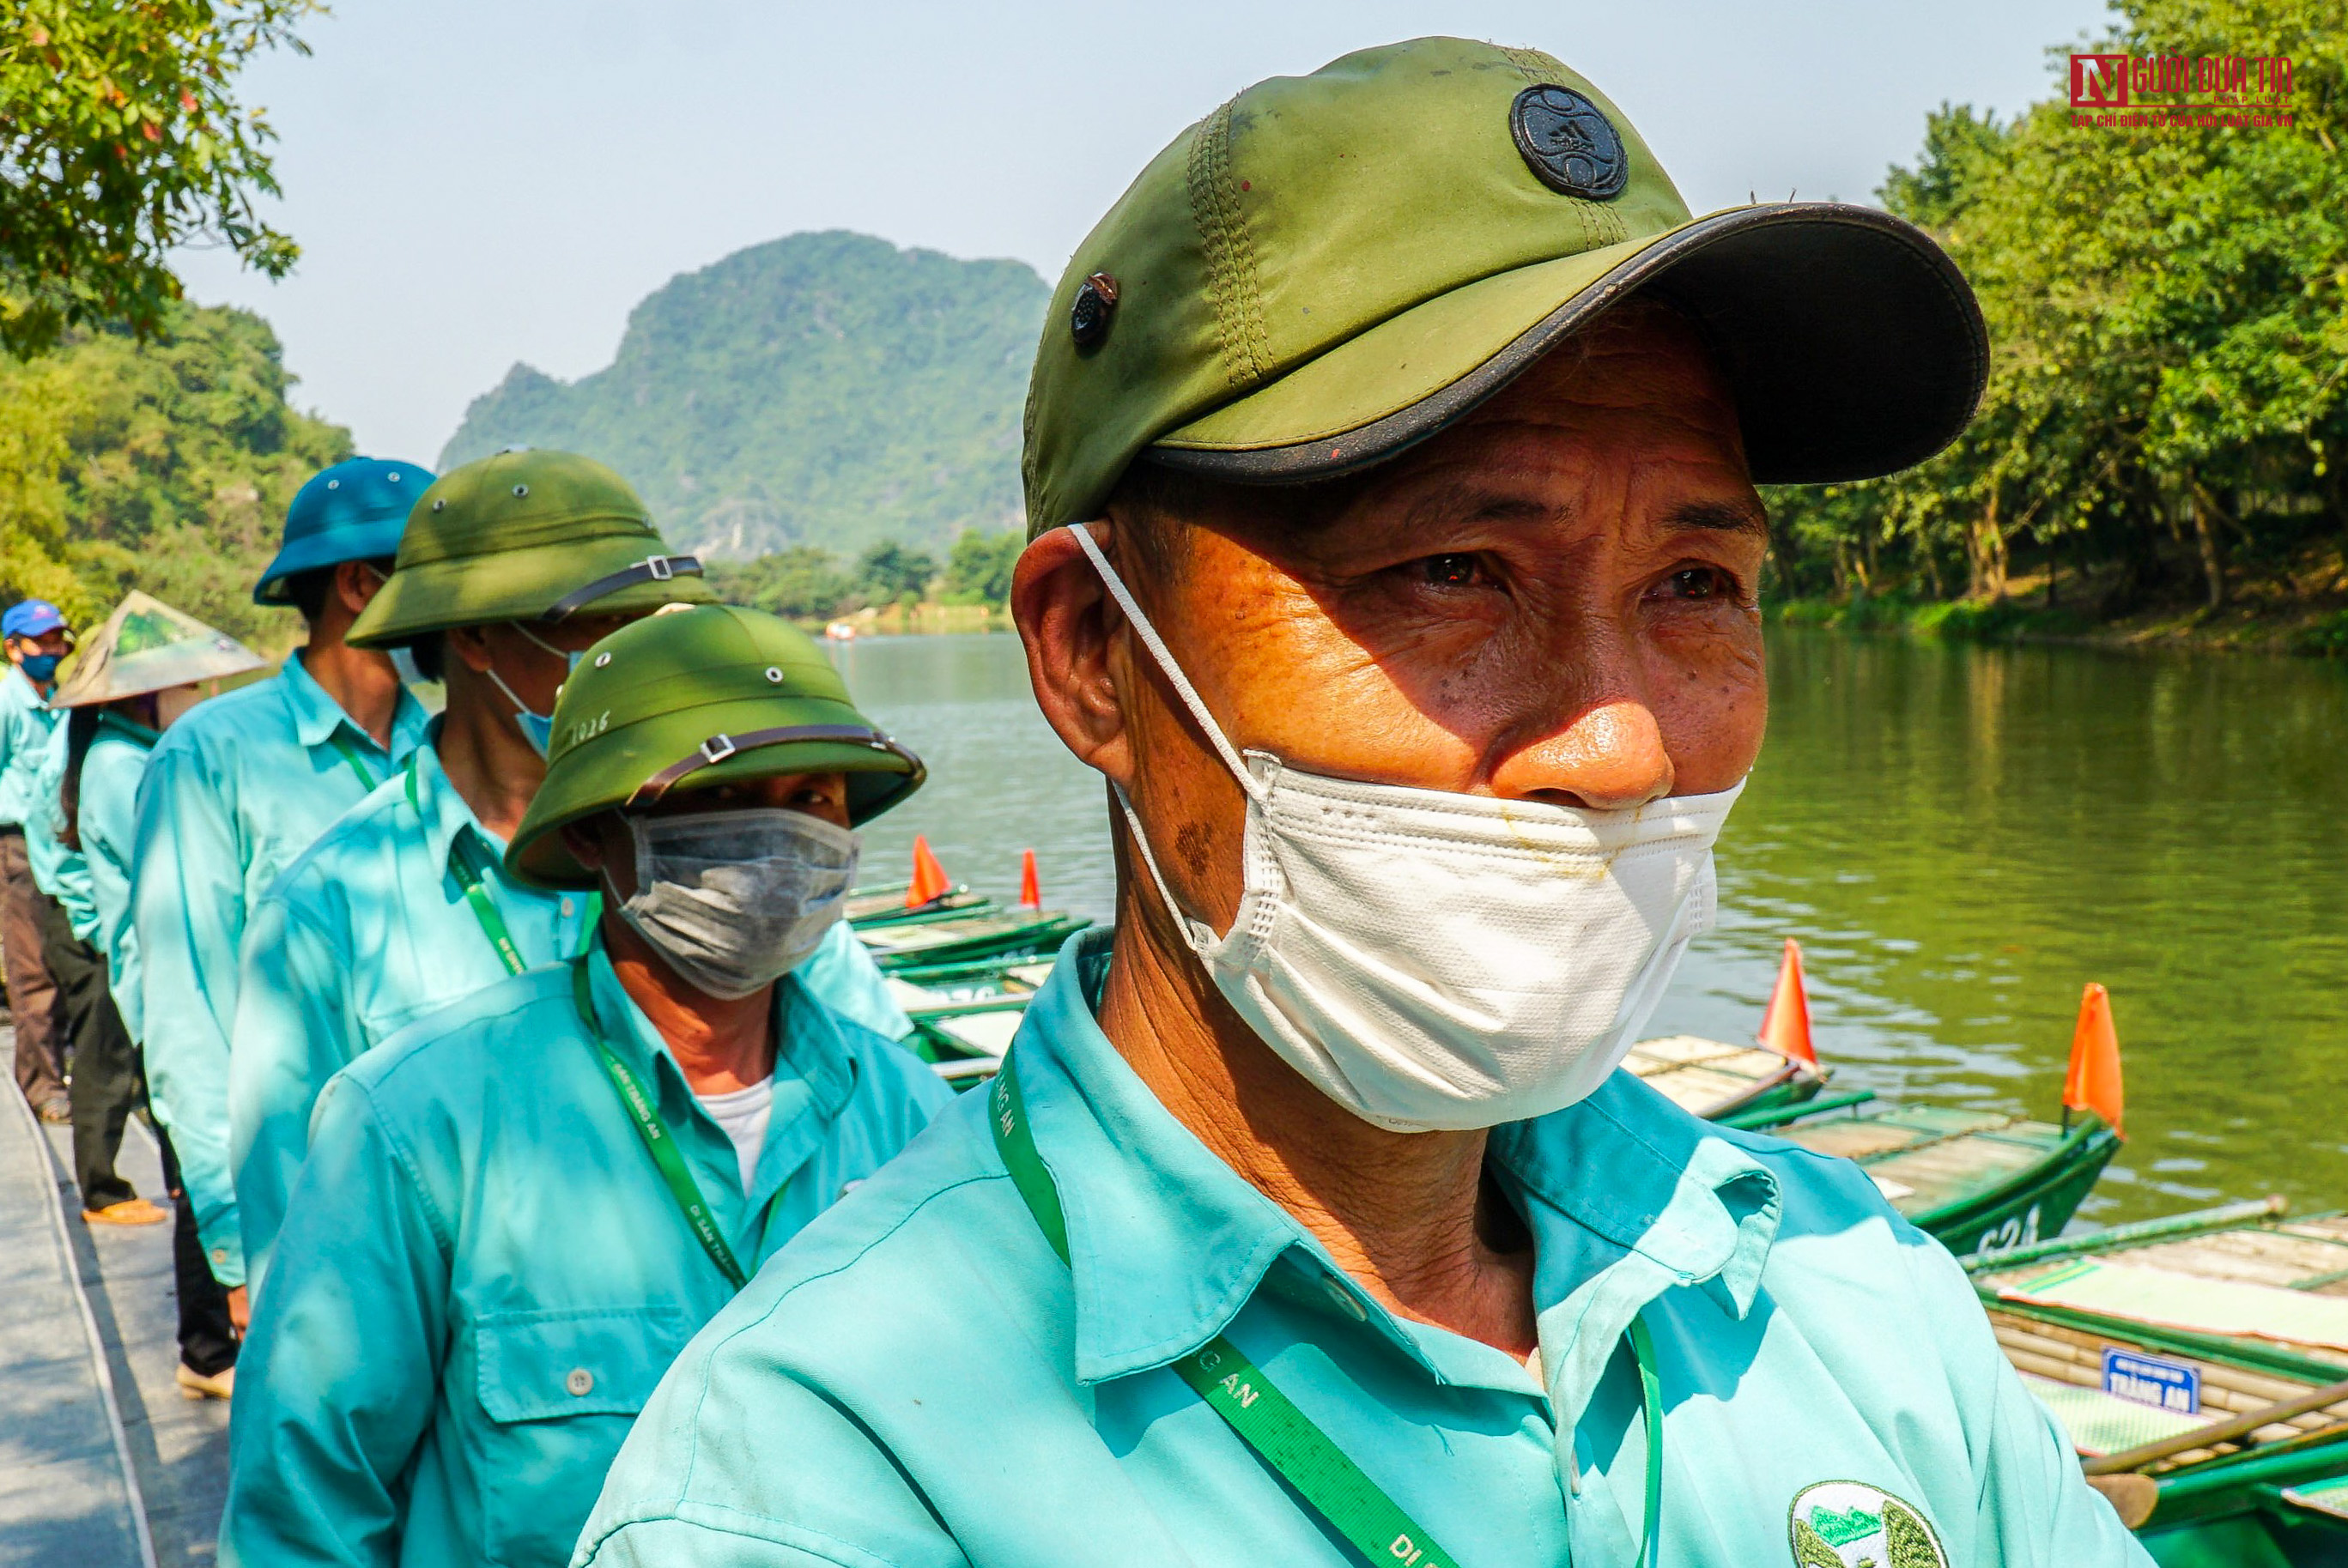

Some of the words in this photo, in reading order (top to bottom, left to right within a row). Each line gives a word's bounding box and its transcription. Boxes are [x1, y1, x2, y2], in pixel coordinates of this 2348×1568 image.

[1000, 1109, 1015, 1138] AN
[1217, 1373, 1259, 1409] AN
[2163, 1384, 2191, 1412] AN
[1388, 1533, 1423, 1567] DI
